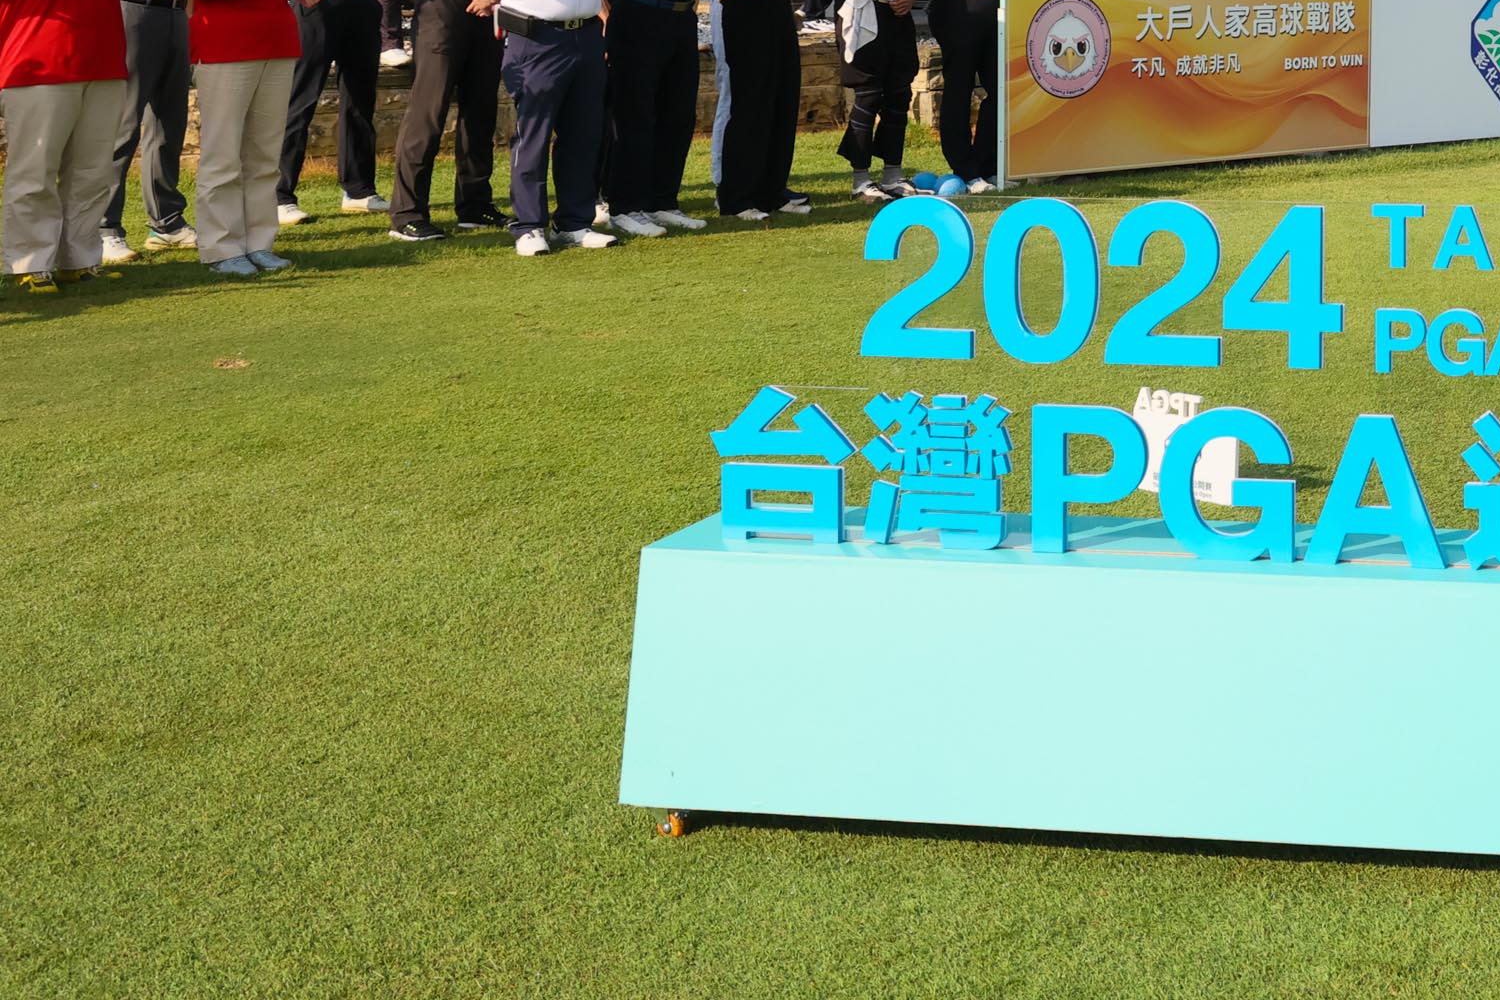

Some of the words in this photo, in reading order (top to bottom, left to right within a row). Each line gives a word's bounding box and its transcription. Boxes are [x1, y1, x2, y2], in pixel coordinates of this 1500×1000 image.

[1131, 57, 1166, 78] 不凡
[1176, 53, 1241, 76] 成就非凡
[1284, 56, 1318, 71] BORN
[1321, 55, 1336, 69] TO
[1340, 54, 1363, 67] WIN
[860, 195, 1345, 370] 2024
